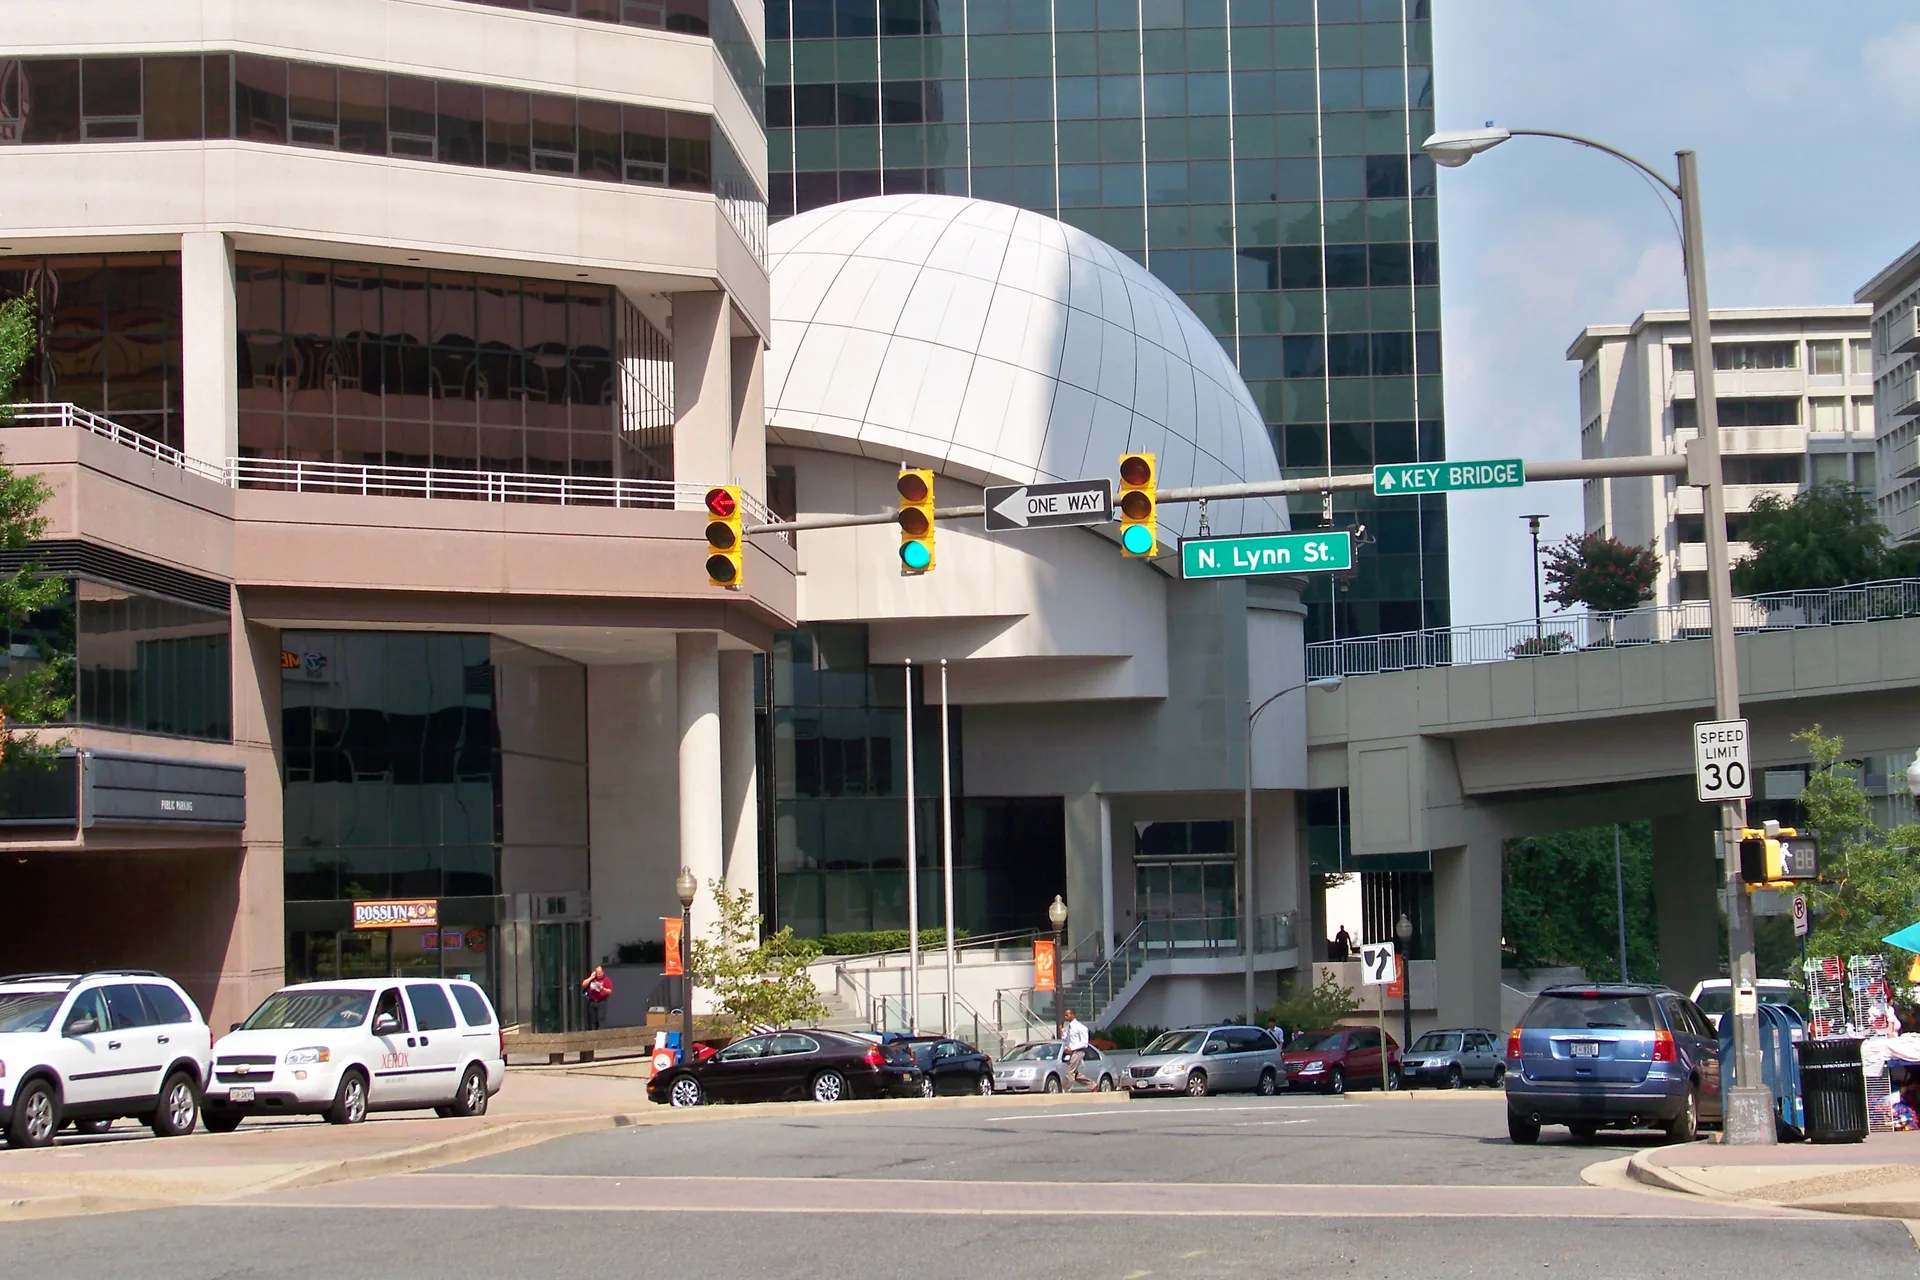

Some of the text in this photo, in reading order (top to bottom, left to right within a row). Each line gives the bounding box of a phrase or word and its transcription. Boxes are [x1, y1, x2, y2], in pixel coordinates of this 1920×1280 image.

[1401, 463, 1519, 489] KEY BRIDGE
[1027, 493, 1100, 514] ONE WAY
[1198, 541, 1336, 571] N. Lynn St.
[1700, 729, 1744, 745] SPEED
[1705, 746, 1740, 760] LIMIT
[1704, 761, 1746, 792] 30
[355, 905, 408, 921] ROSSLYN
[382, 1052, 409, 1069] XEROX
